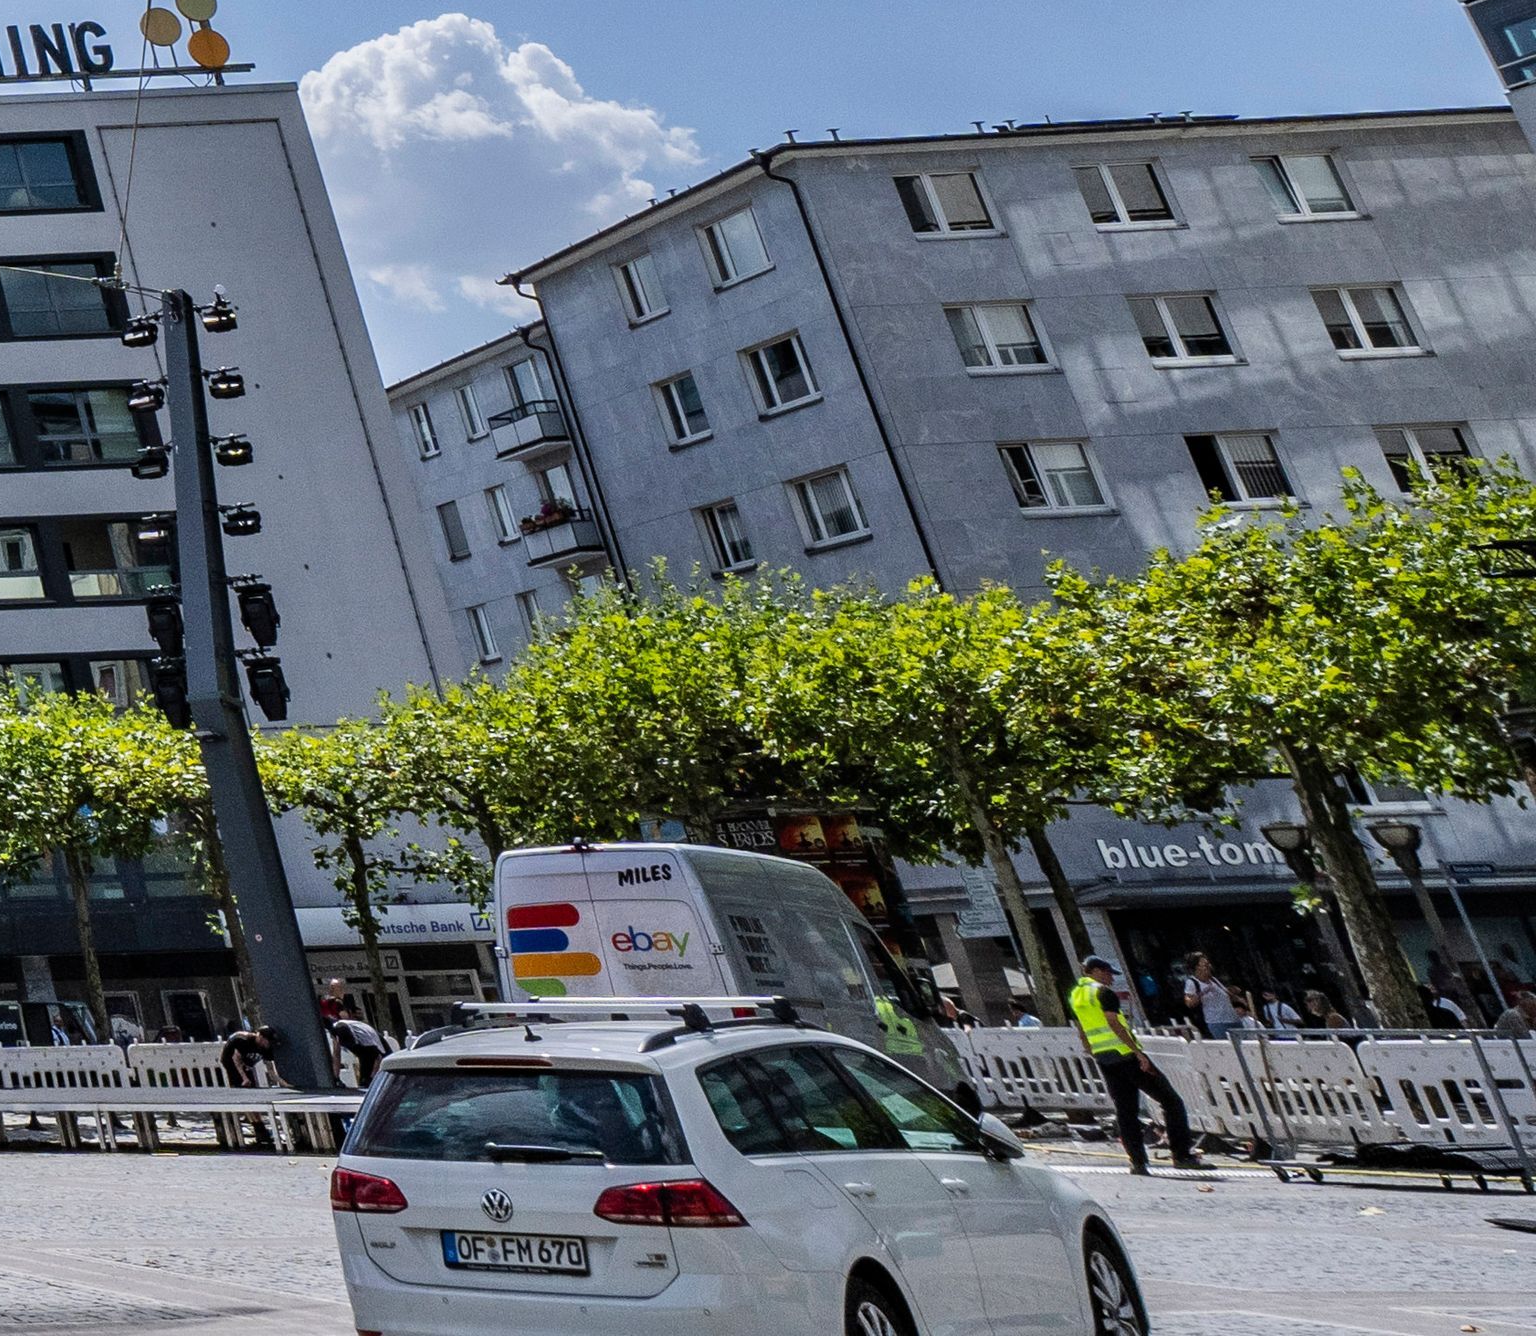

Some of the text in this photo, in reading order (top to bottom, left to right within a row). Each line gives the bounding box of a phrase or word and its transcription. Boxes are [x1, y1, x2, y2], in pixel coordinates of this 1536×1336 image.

[1096, 835, 1285, 870] blue-tom
[617, 864, 672, 887] MILES
[430, 921, 466, 933] Bank
[610, 924, 690, 958] ebay
[458, 1235, 583, 1266] OF FM 670
